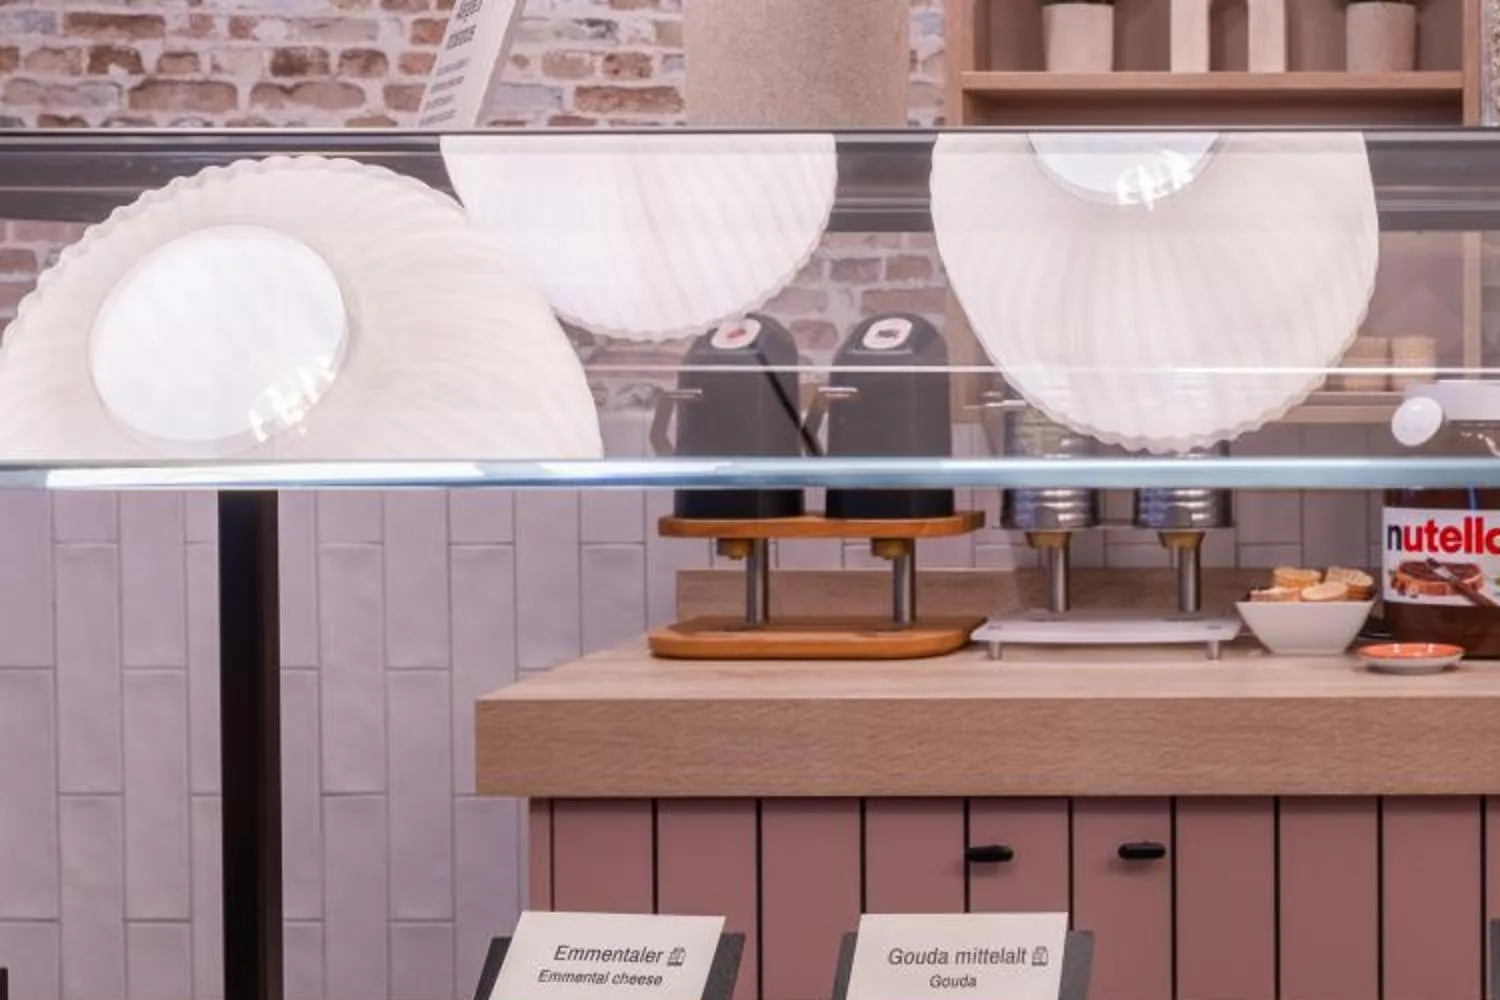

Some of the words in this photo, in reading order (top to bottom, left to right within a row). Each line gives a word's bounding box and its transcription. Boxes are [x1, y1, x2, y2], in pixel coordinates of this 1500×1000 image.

[553, 945, 663, 964] Emmentaler
[888, 947, 948, 966] Gouda
[955, 947, 1026, 965] mittelalt
[538, 969, 609, 985] Emmental
[611, 970, 663, 986] cheese
[929, 975, 977, 988] Gouda
